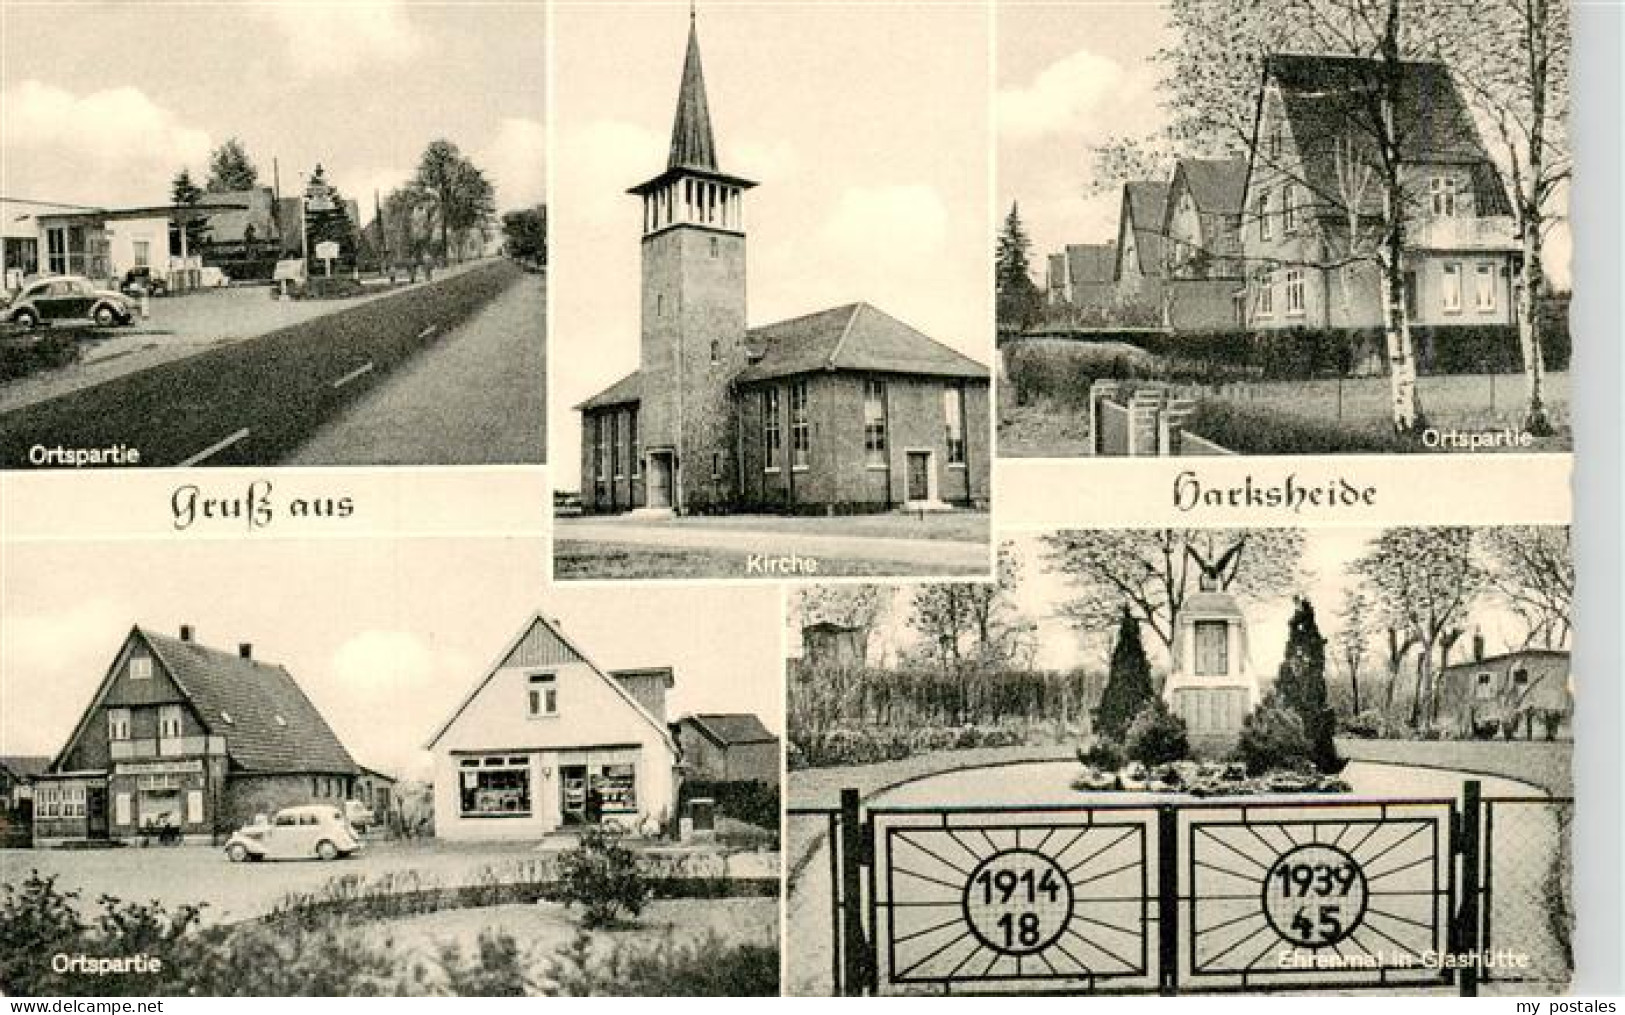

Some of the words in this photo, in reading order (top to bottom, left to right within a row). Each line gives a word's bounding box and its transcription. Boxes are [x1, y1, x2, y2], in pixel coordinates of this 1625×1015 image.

[976, 868, 1060, 904] 1914
[1275, 864, 1356, 898] 1939
[997, 912, 1039, 947] 18
[1291, 906, 1342, 939] 45
